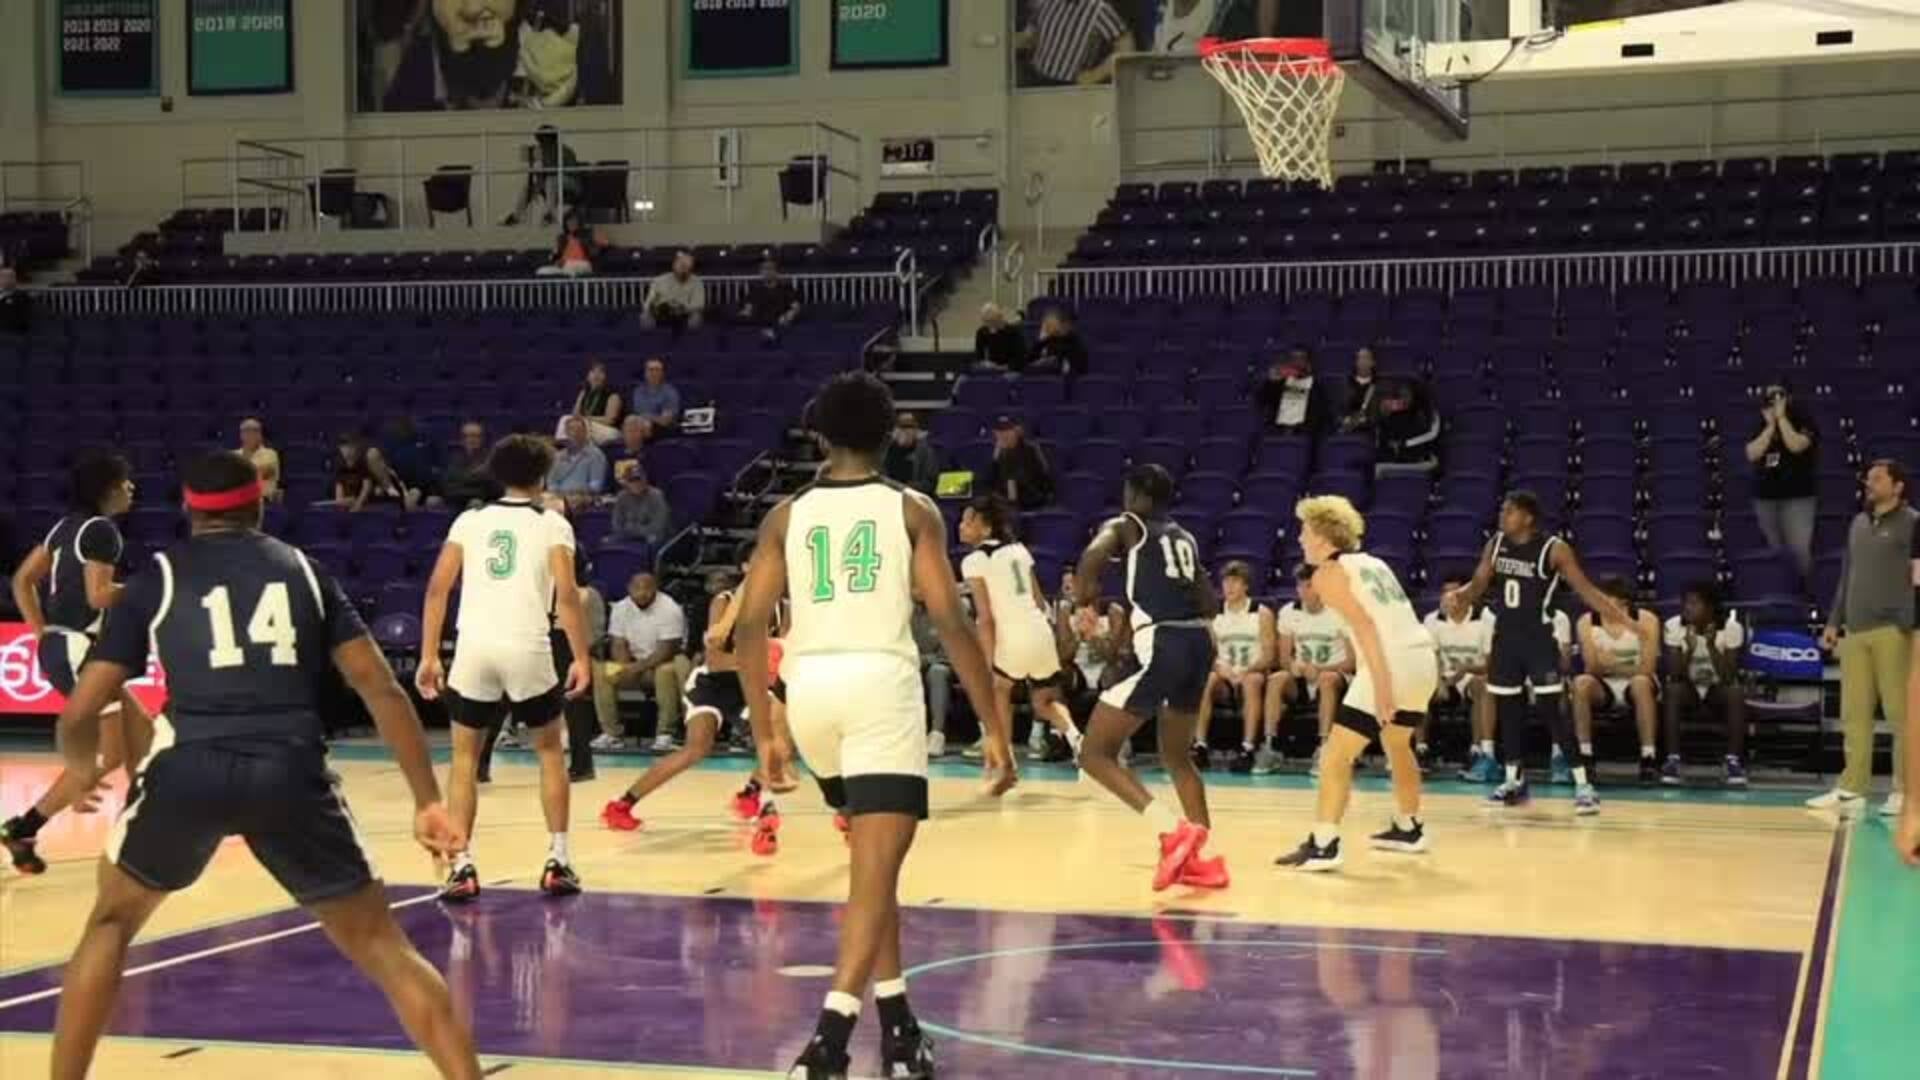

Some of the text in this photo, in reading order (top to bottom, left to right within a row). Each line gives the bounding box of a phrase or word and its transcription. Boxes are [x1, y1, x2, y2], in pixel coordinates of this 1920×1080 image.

[838, 4, 886, 20] 2020
[486, 529, 517, 580] 3
[806, 519, 882, 603] 14
[1158, 534, 1196, 582] 10
[1012, 559, 1027, 594] 1
[1504, 578, 1520, 608] 0
[200, 582, 297, 668] 14
[1750, 642, 1820, 662] GEICO
